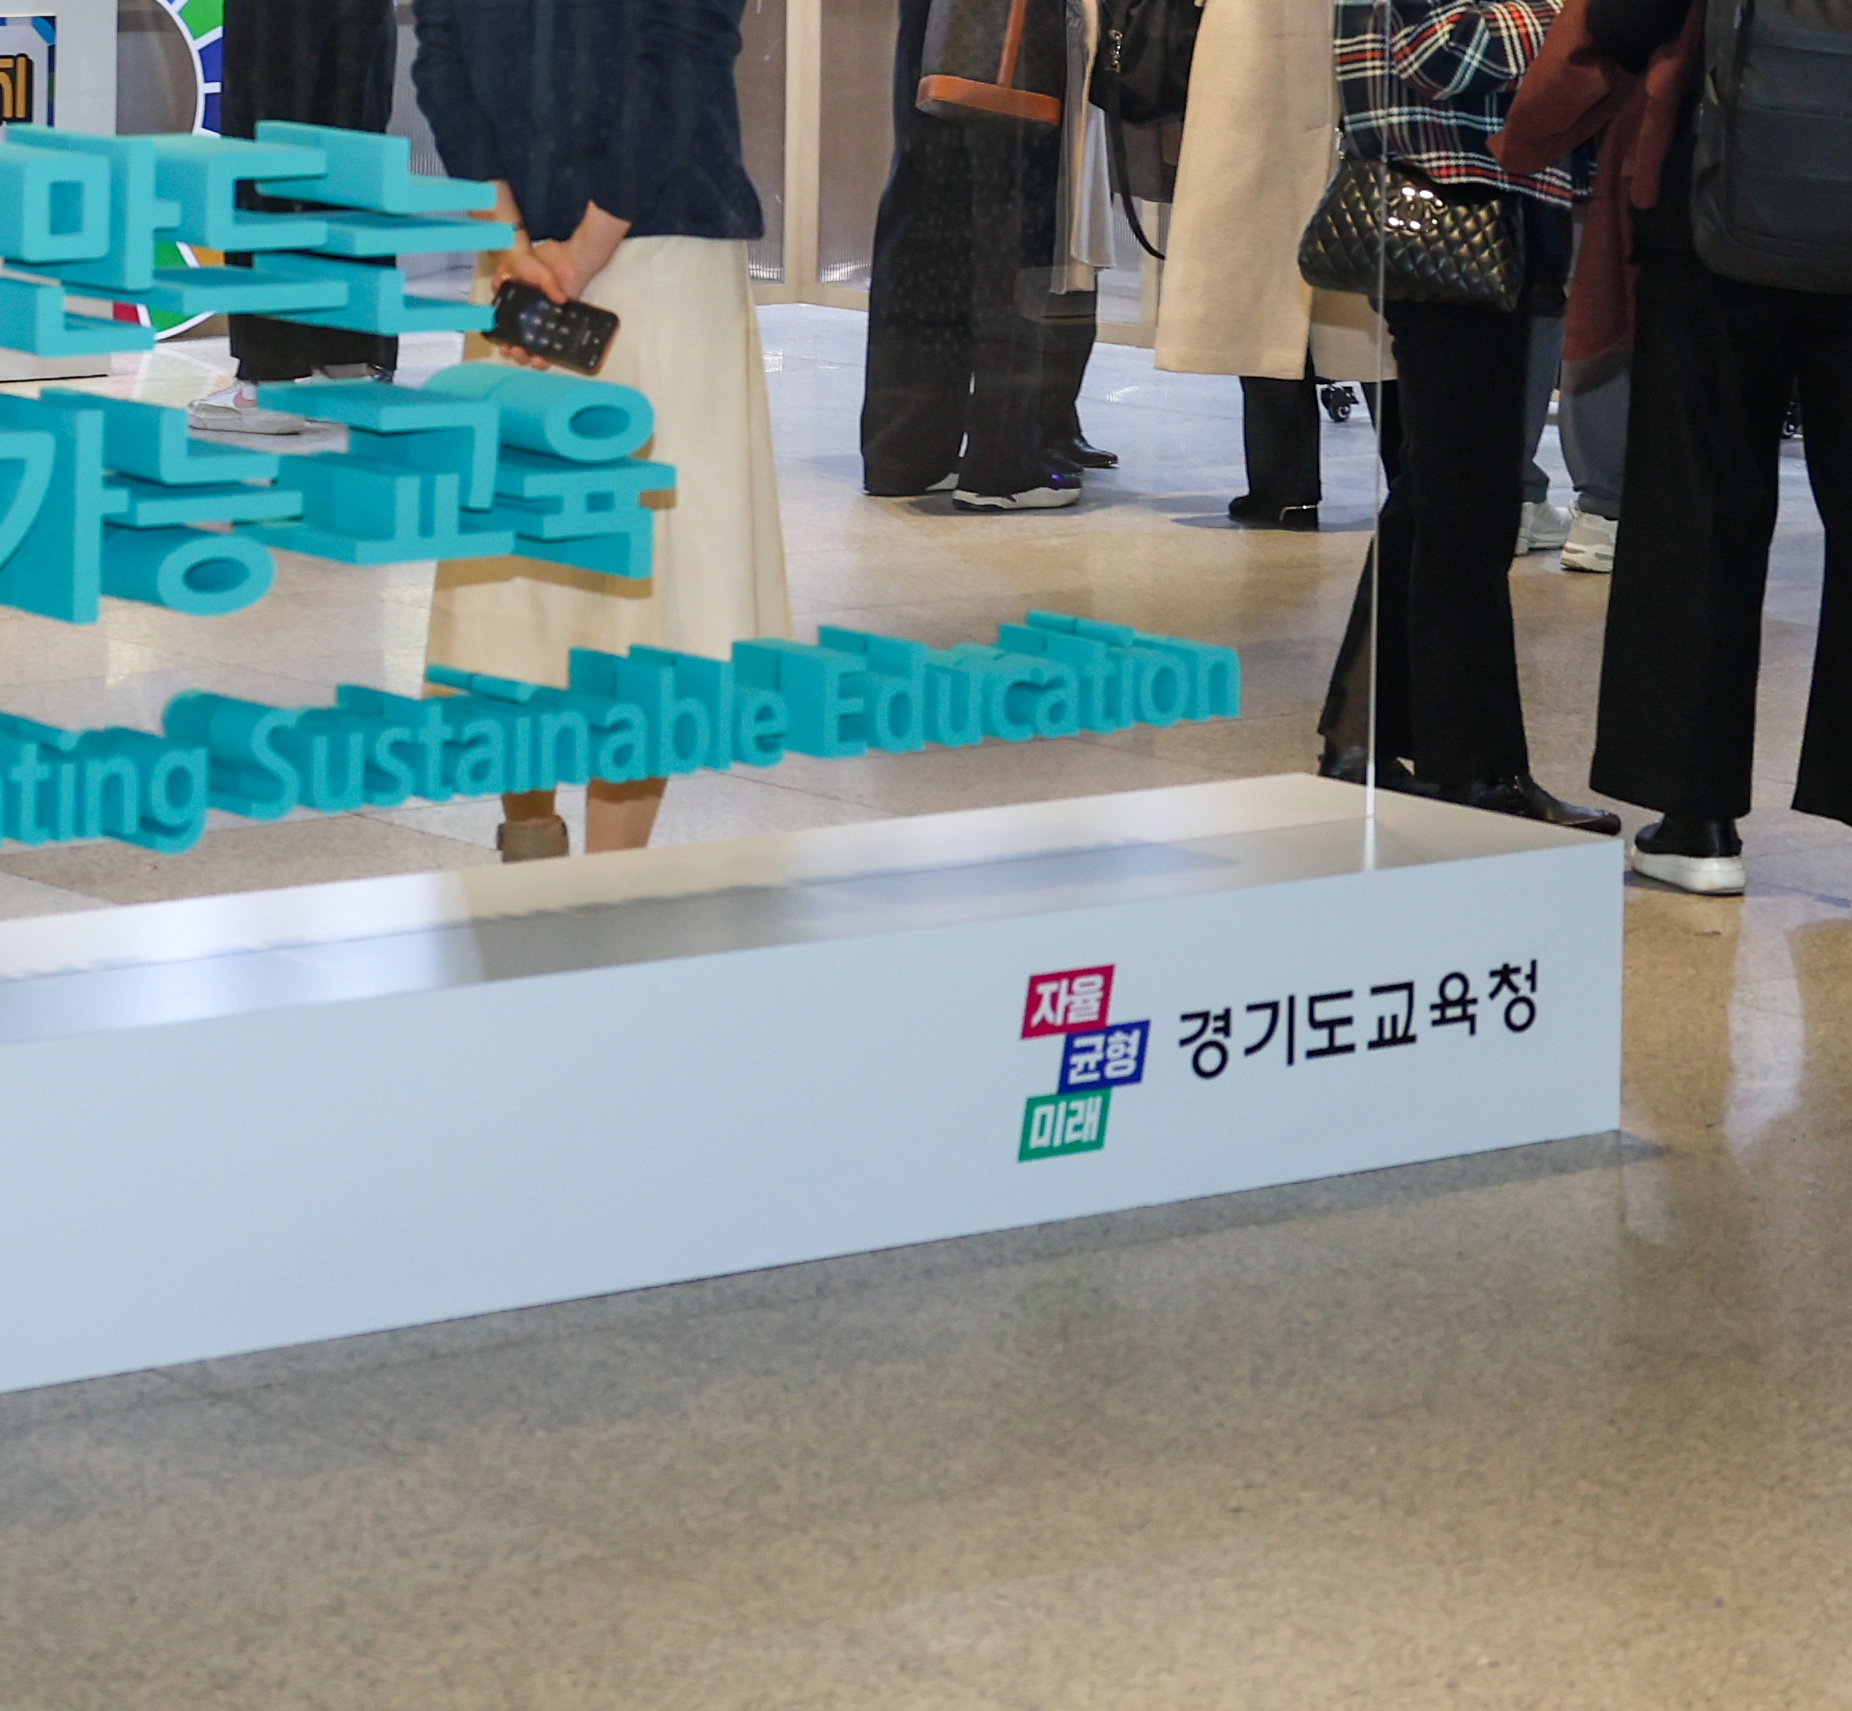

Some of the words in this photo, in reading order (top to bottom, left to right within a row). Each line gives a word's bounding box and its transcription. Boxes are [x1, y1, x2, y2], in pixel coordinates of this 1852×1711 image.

[242, 362, 676, 578] 교육
[178, 648, 791, 823] Sustainable
[743, 610, 1239, 758] Education
[1028, 972, 1106, 1028] 자율
[1177, 958, 1539, 1080] 경기도교육청
[1065, 1029, 1140, 1086] 균형
[1028, 1096, 1101, 1151] 미래
